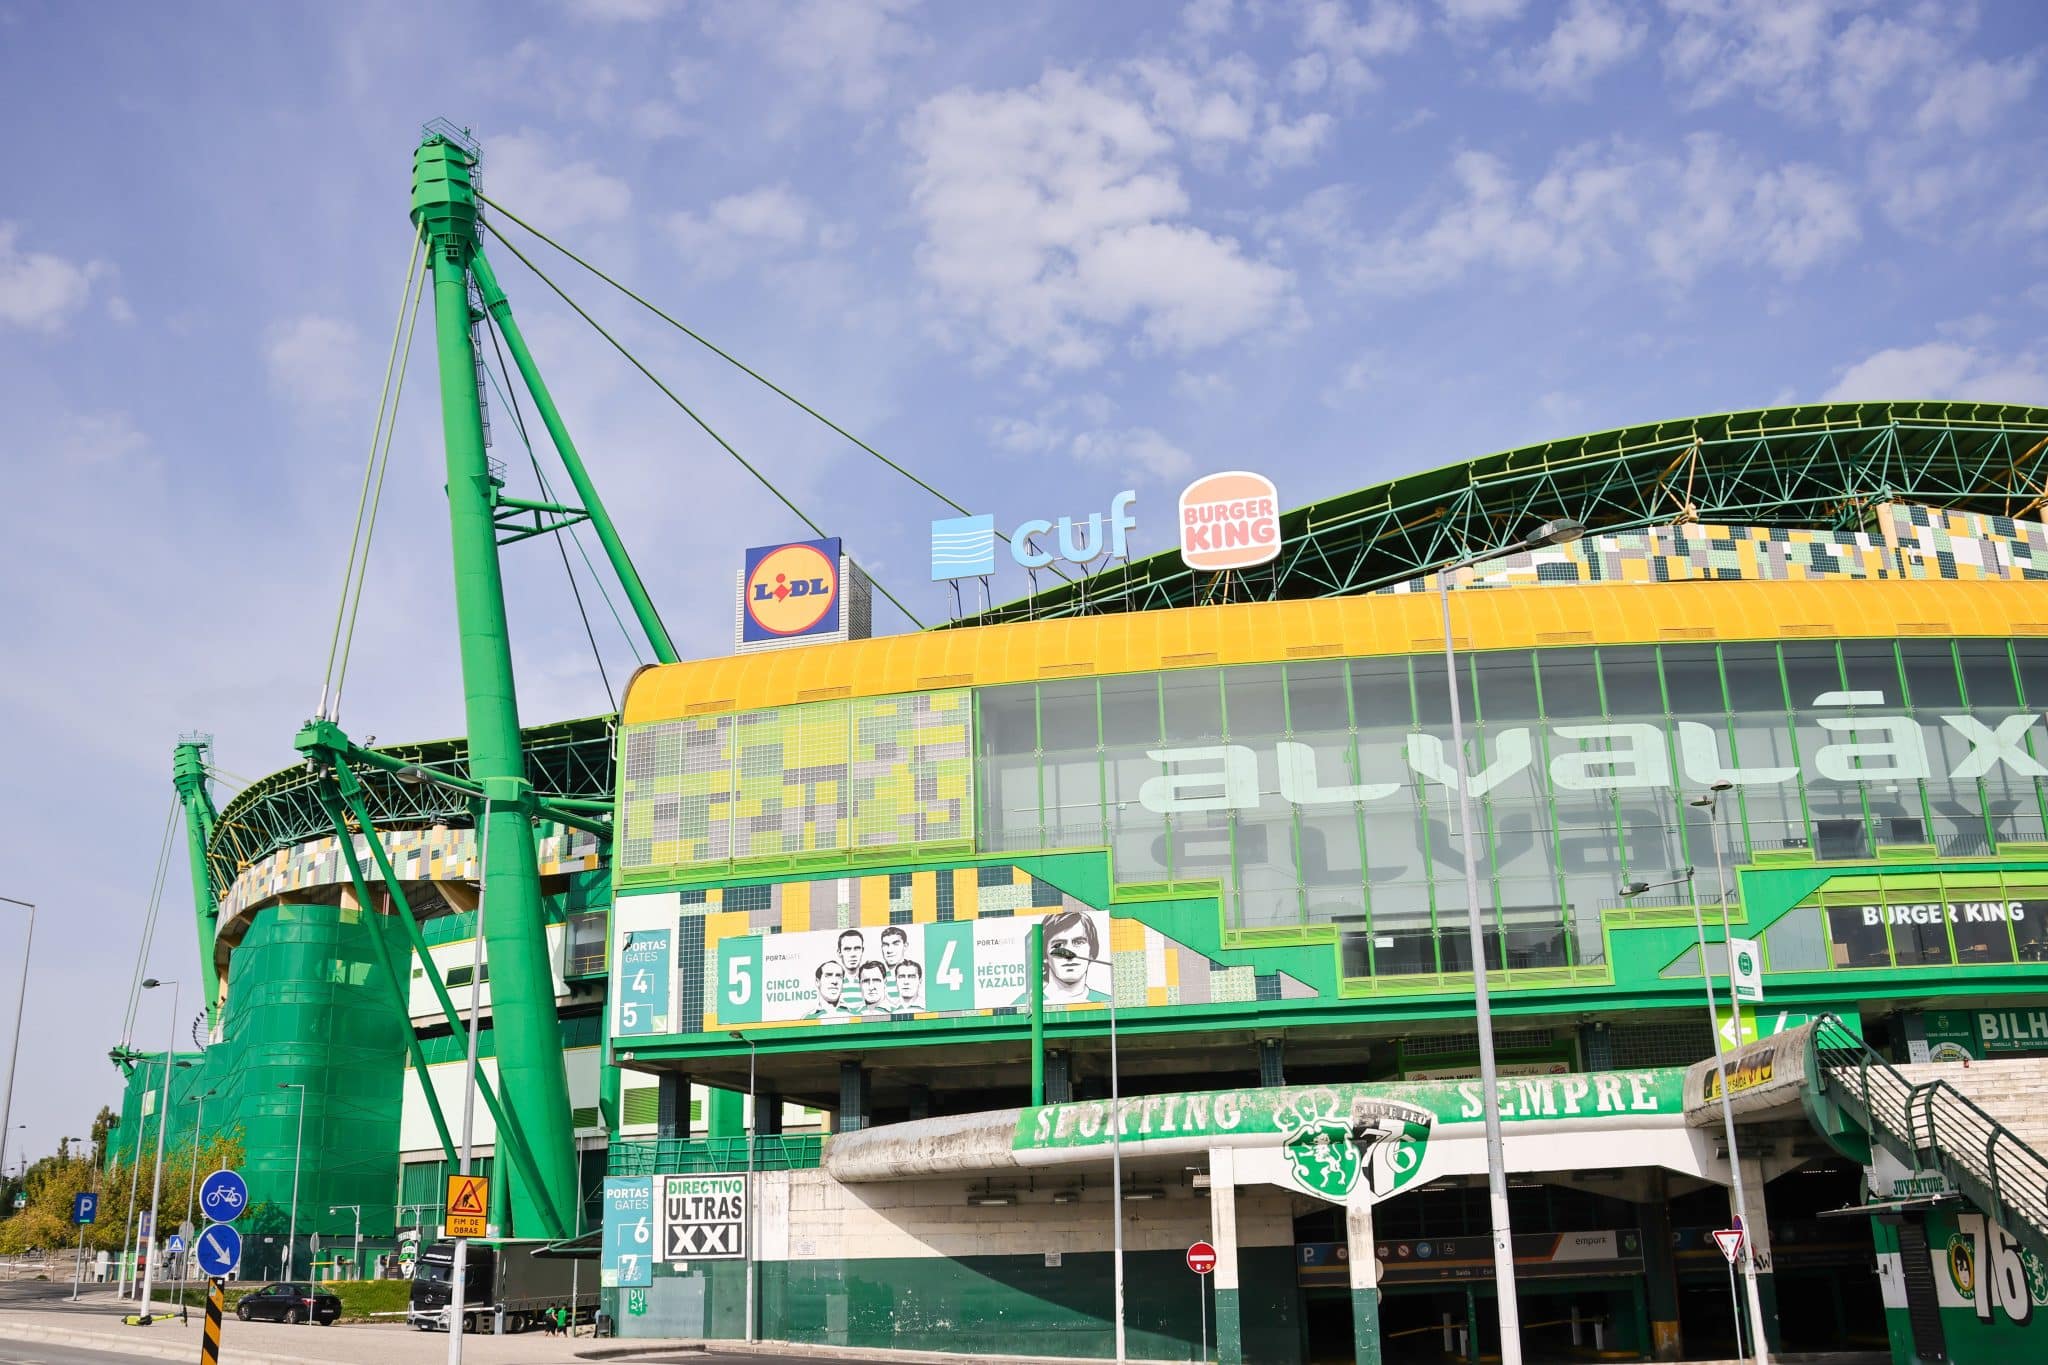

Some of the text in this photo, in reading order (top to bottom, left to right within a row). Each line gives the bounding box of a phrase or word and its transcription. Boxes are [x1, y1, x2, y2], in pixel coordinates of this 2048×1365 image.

[1184, 499, 1274, 525] BURGER
[1010, 490, 1136, 569] cuf
[1185, 518, 1275, 552] KING
[1862, 902, 2025, 926] BURGER KING
[625, 951, 659, 963] GATES
[936, 940, 964, 991] 4
[977, 962, 1025, 976] HÉCTOR
[632, 968, 648, 994] 4
[728, 955, 752, 1005] 5
[766, 979, 800, 991] CINCO
[766, 990, 818, 1002] VIOLINOS
[623, 1002, 638, 1028] 5
[1457, 1074, 1658, 1118] SEMPRE
[607, 1187, 649, 1199] PORTAS
[668, 1180, 743, 1194] DIRECTIVO
[1894, 1176, 1945, 1195] JUVENTUDE
[615, 1199, 649, 1210] GATES
[668, 1195, 742, 1220] ULTRAS
[454, 1226, 478, 1234] OBRAS
[634, 1216, 649, 1243] 6
[672, 1224, 738, 1253] XXI
[622, 1254, 638, 1281] 7
[1957, 1213, 2029, 1320] 76
